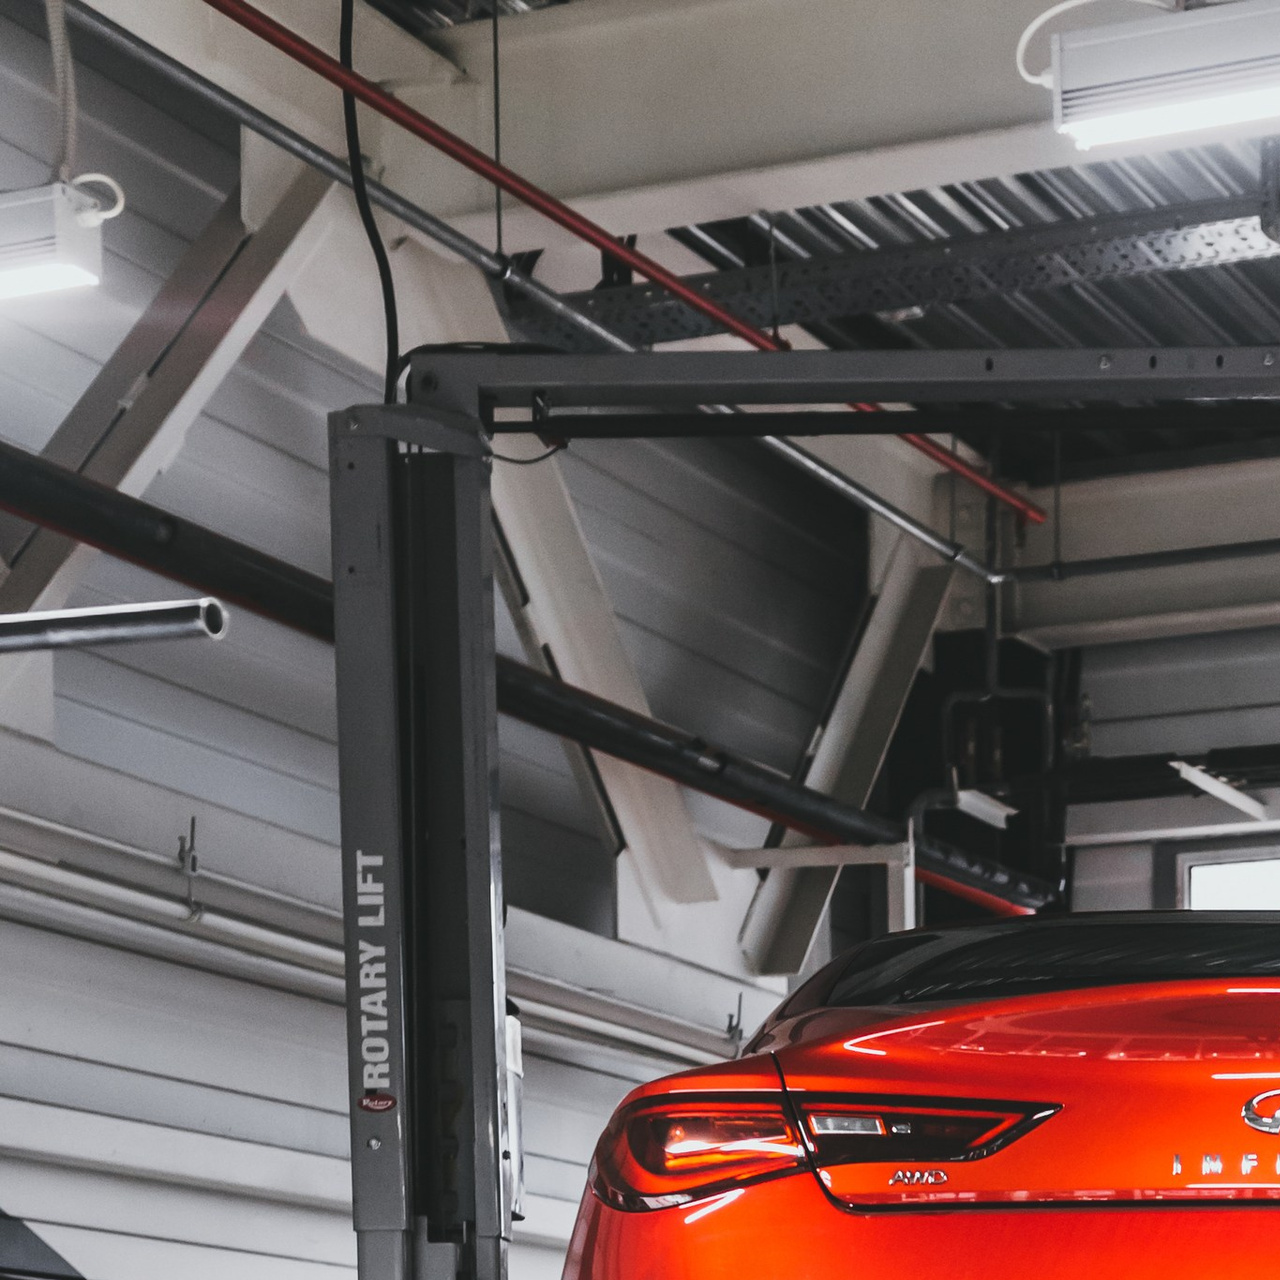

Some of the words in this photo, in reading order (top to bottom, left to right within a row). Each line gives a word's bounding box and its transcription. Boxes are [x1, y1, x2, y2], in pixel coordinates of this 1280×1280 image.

[356, 850, 385, 926] LIFT
[358, 939, 390, 1089] ROTARY
[888, 1170, 948, 1185] AWD
